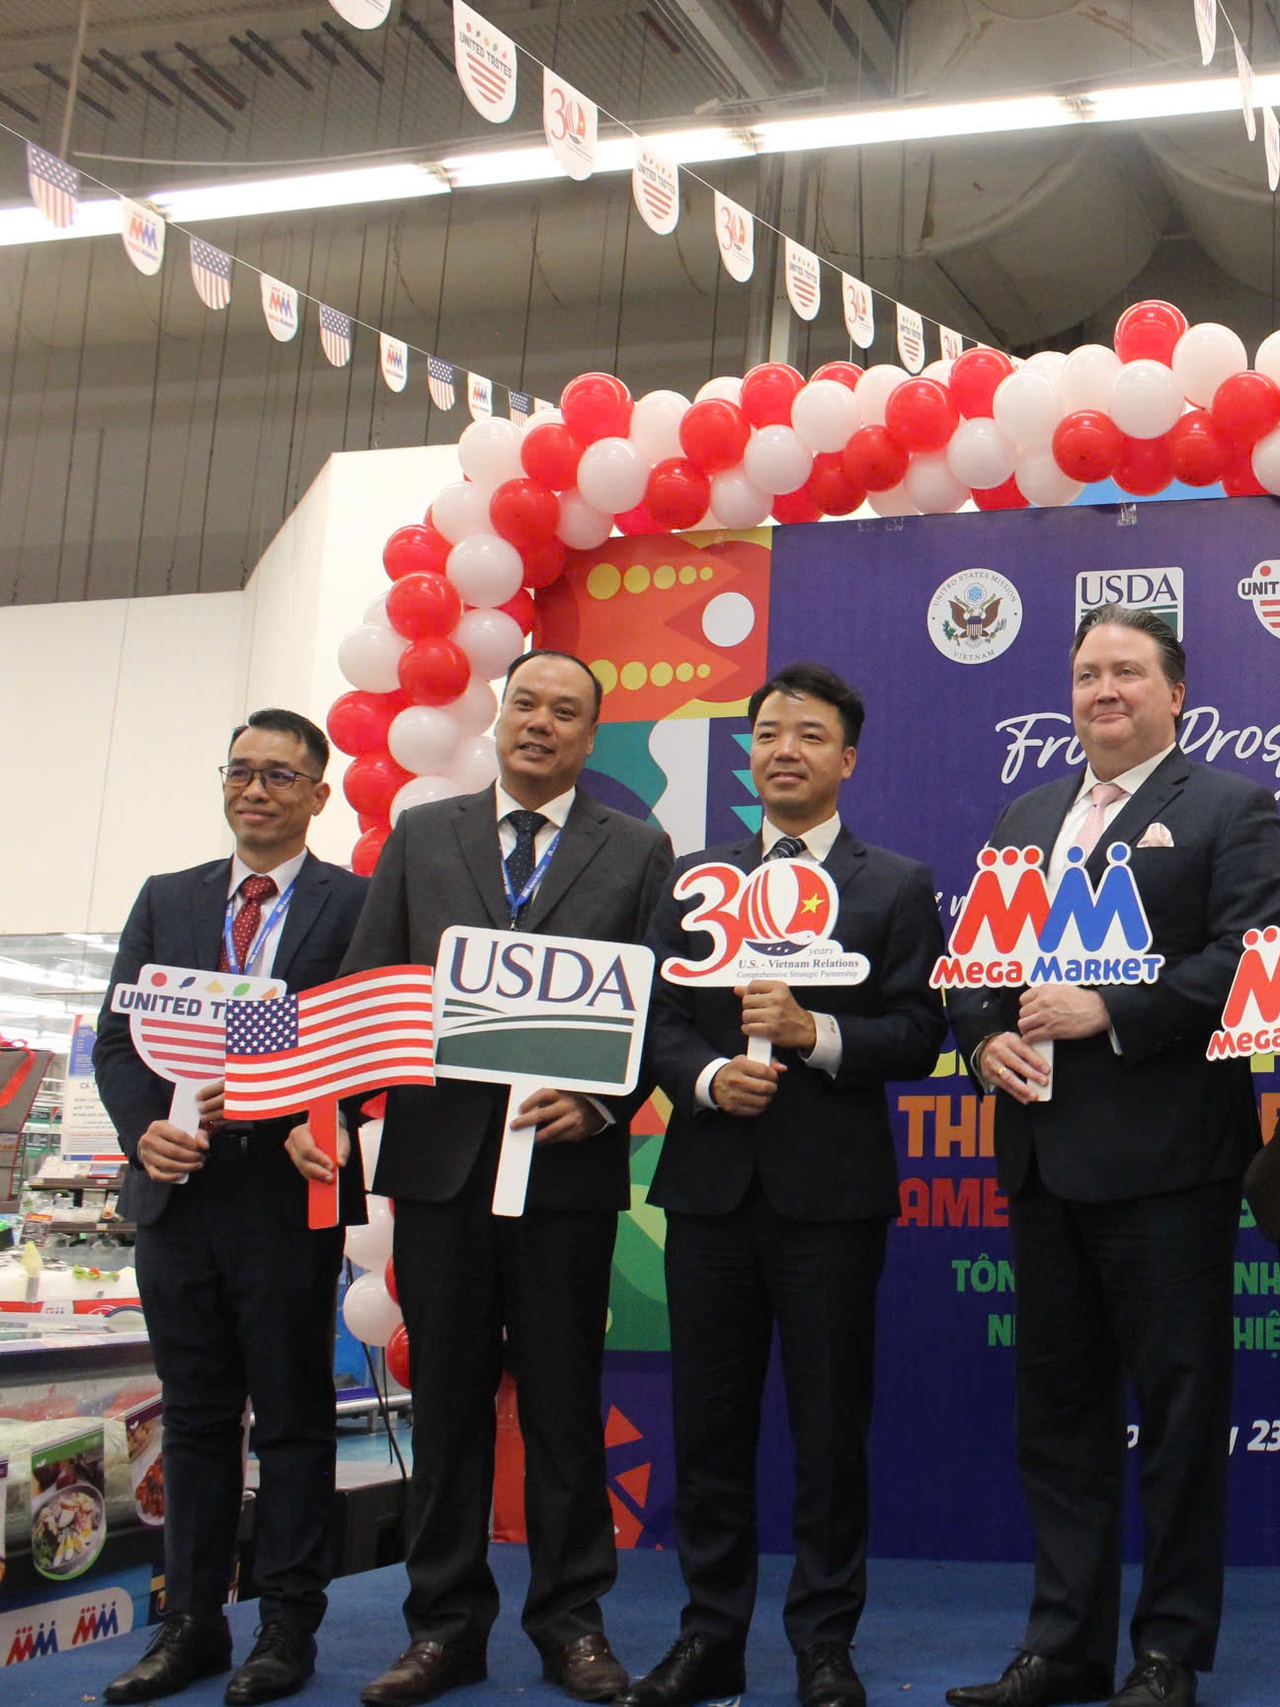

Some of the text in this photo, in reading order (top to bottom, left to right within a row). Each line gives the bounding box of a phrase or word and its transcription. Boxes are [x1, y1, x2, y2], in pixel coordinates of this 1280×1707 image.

[459, 31, 512, 80] UNITED TASTES
[933, 572, 1016, 606] UNITED STATES MISSION
[1081, 573, 1178, 605] USDA
[953, 649, 995, 661] VIETNAM
[739, 960, 759, 969] U.S.
[768, 959, 809, 968] Vietnam
[813, 959, 859, 968] Relations
[807, 947, 833, 957] years
[450, 937, 636, 1011] USDA
[737, 970, 858, 980] Comprehensive Strategic Partnership
[119, 990, 201, 1017] UNITED
